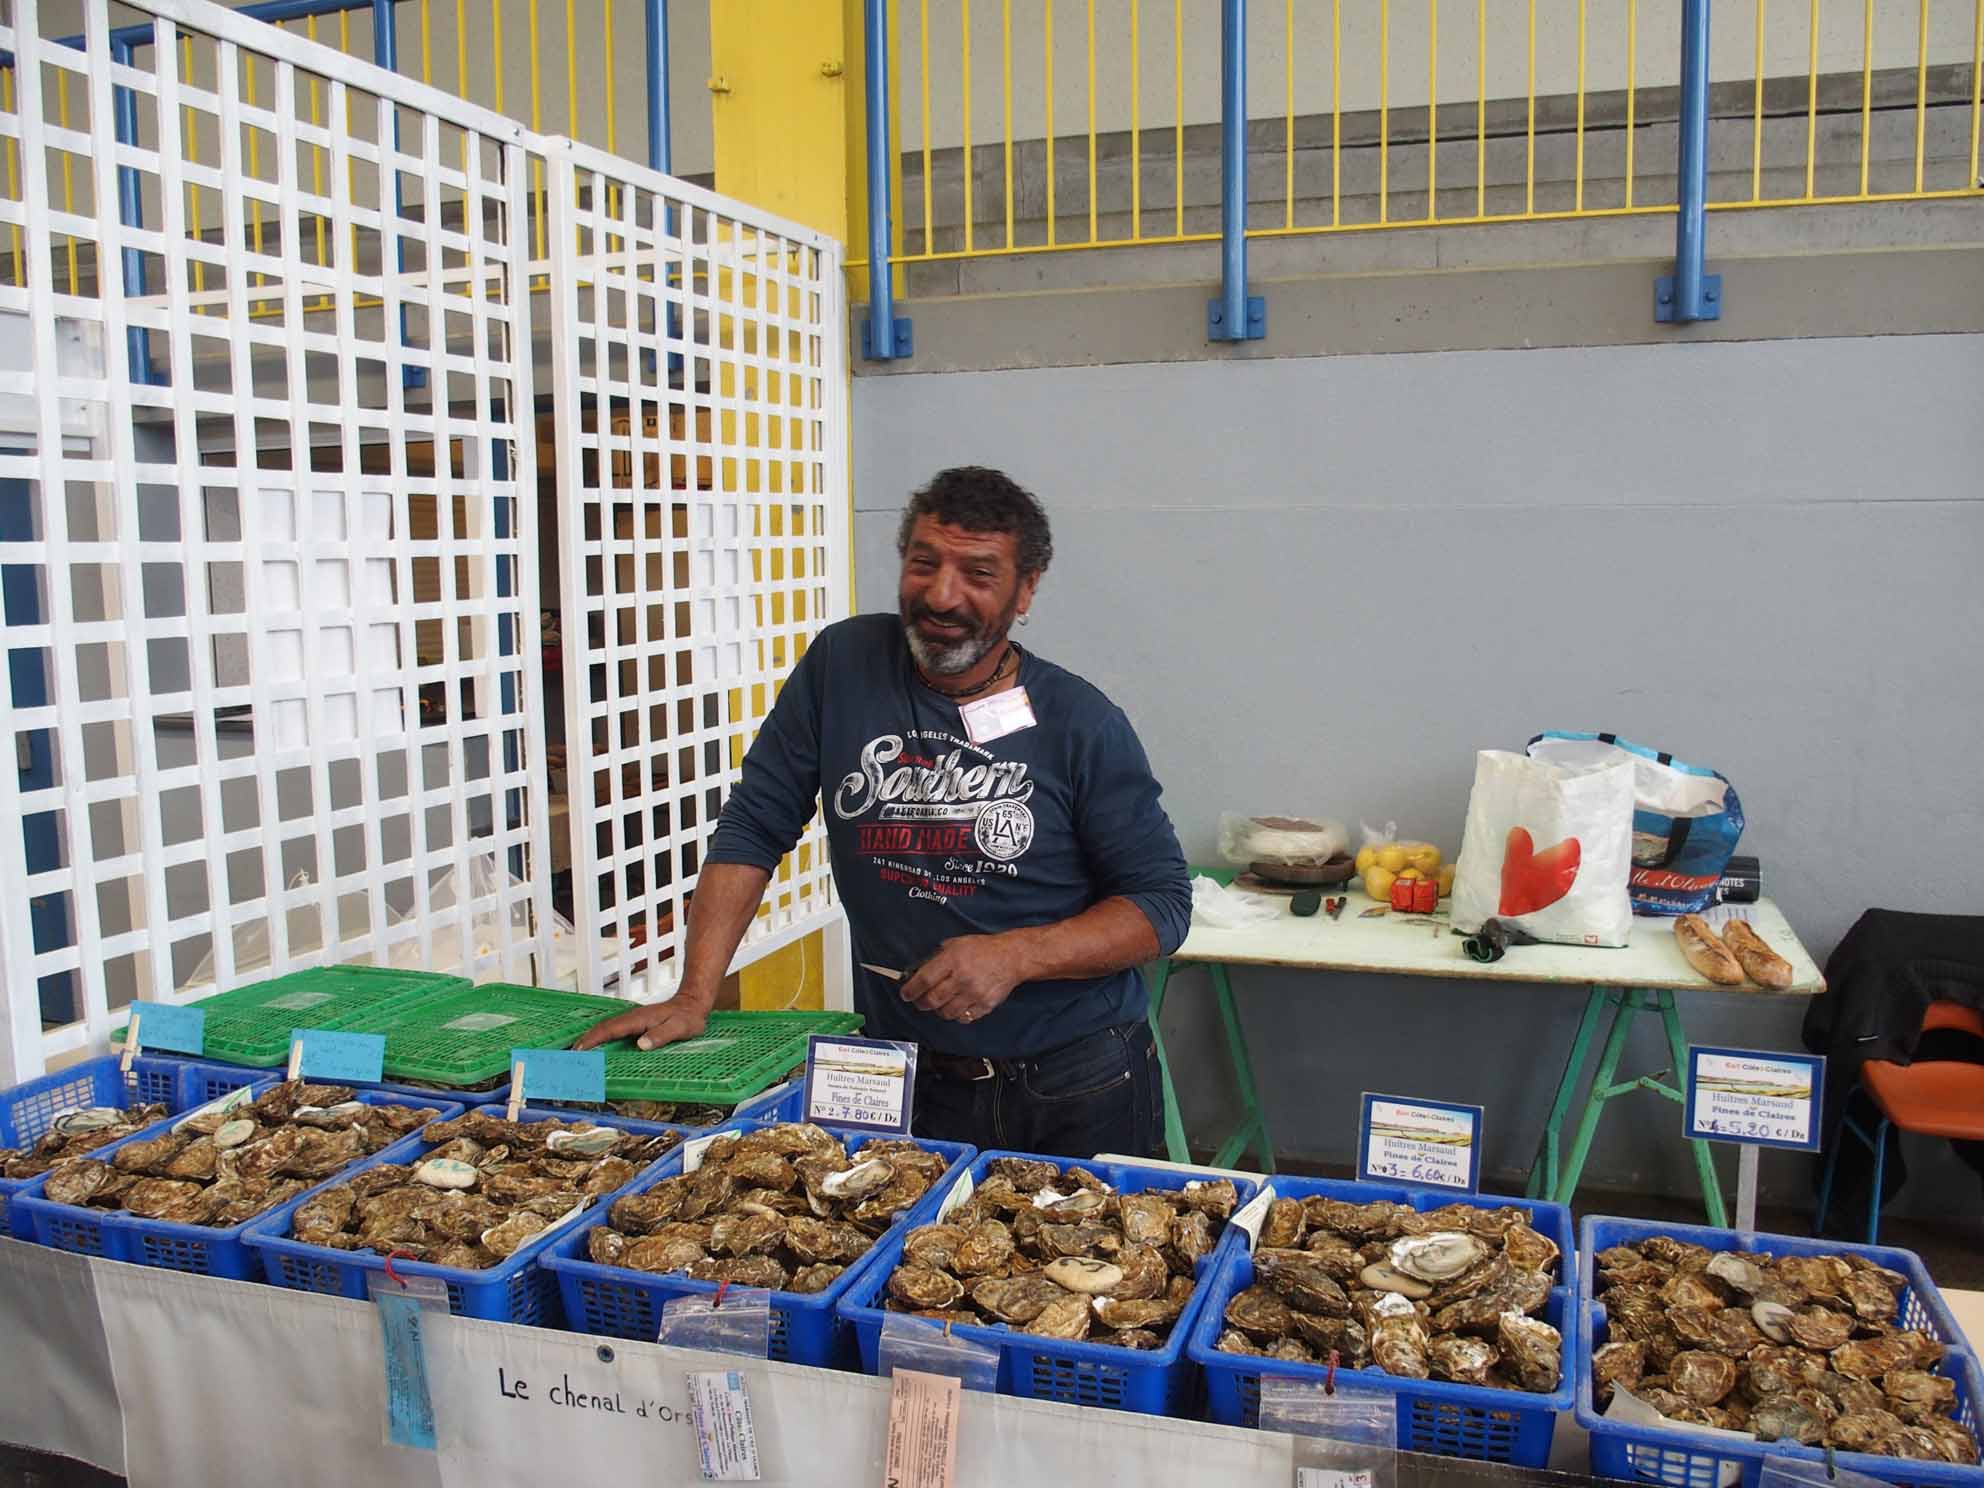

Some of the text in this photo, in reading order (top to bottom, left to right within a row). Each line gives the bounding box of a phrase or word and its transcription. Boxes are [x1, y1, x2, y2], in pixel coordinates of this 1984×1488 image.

[835, 734, 1035, 820] Southern
[859, 828, 971, 850] HAND MADE
[908, 886, 948, 905] Clothing
[832, 1092, 889, 1108] Fines de Claires
[1712, 1105, 1796, 1121] Fines de Claires
[1384, 1151, 1458, 1167] Fines de Claires
[499, 1367, 530, 1400] Le
[549, 1373, 627, 1414] chenal
